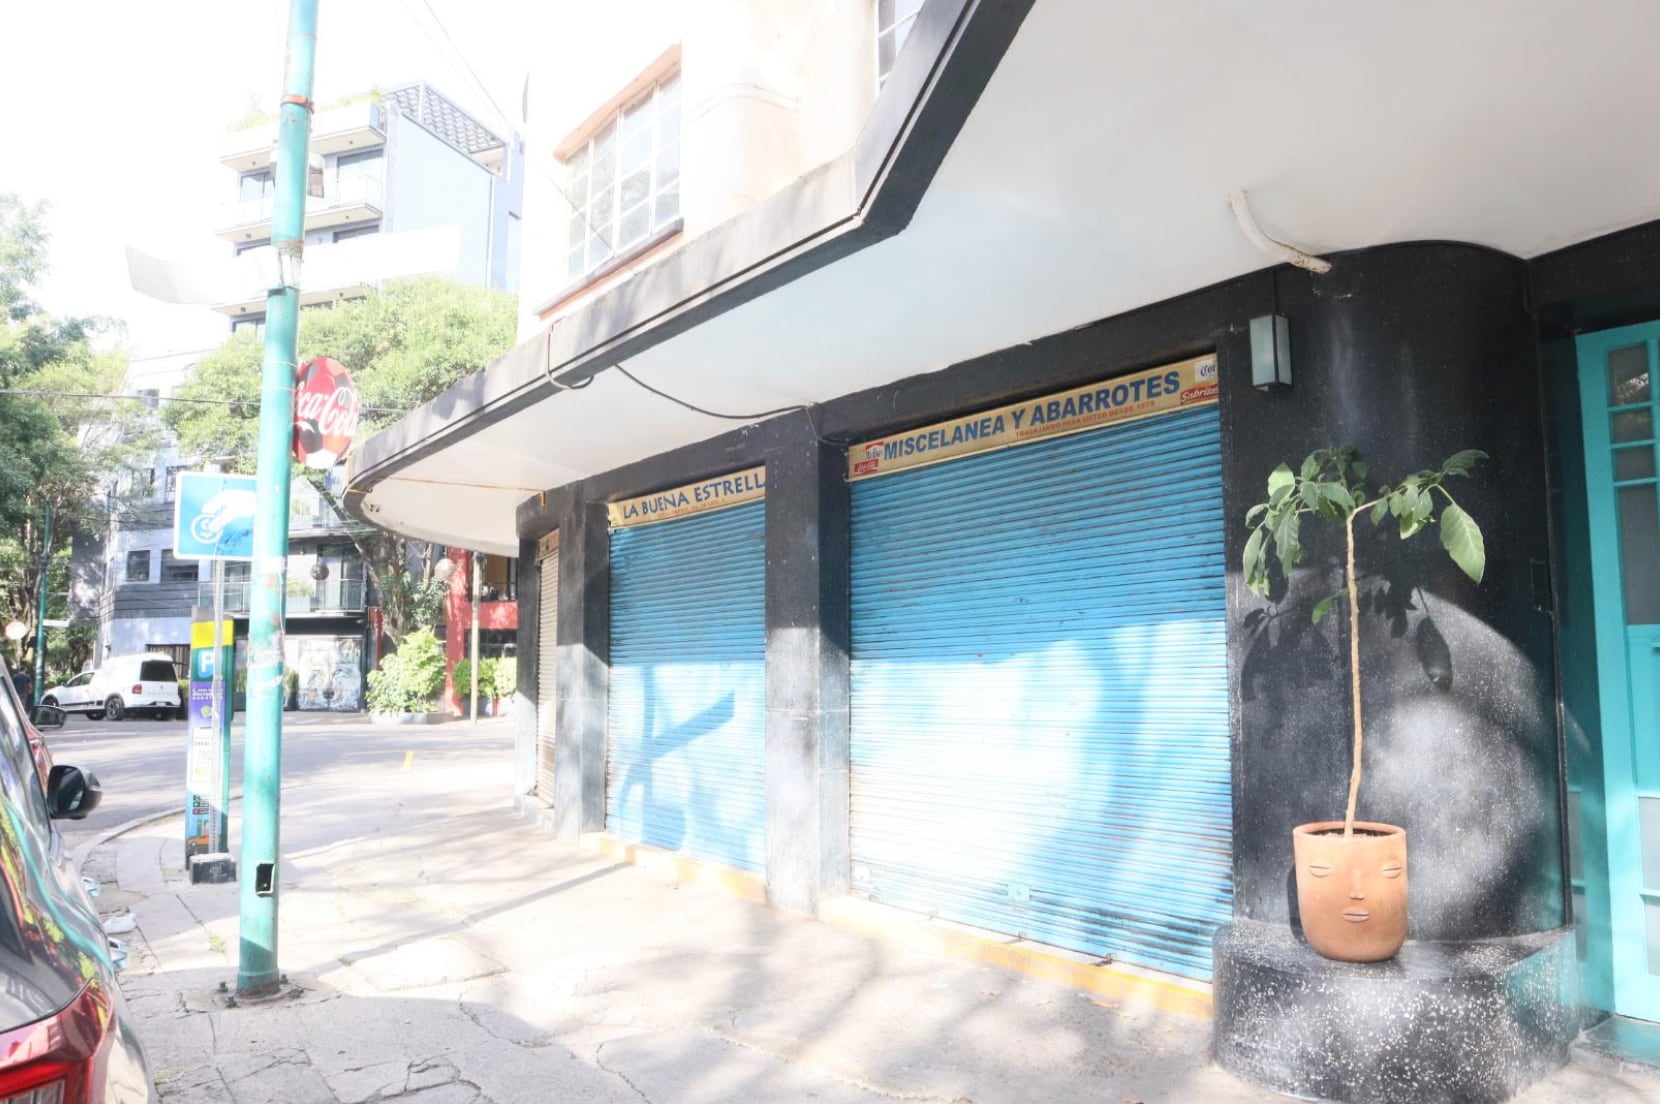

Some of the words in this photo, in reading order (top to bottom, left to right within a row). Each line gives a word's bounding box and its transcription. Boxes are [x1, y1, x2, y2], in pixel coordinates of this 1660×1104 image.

[883, 415, 1005, 461] MISCELANEA
[1011, 409, 1026, 429] Y
[1030, 371, 1180, 426] ABARROTES
[1062, 417, 1081, 428] PARA
[623, 503, 639, 519] LA
[642, 491, 689, 515] BUENA
[694, 473, 765, 502] ESTRELL
